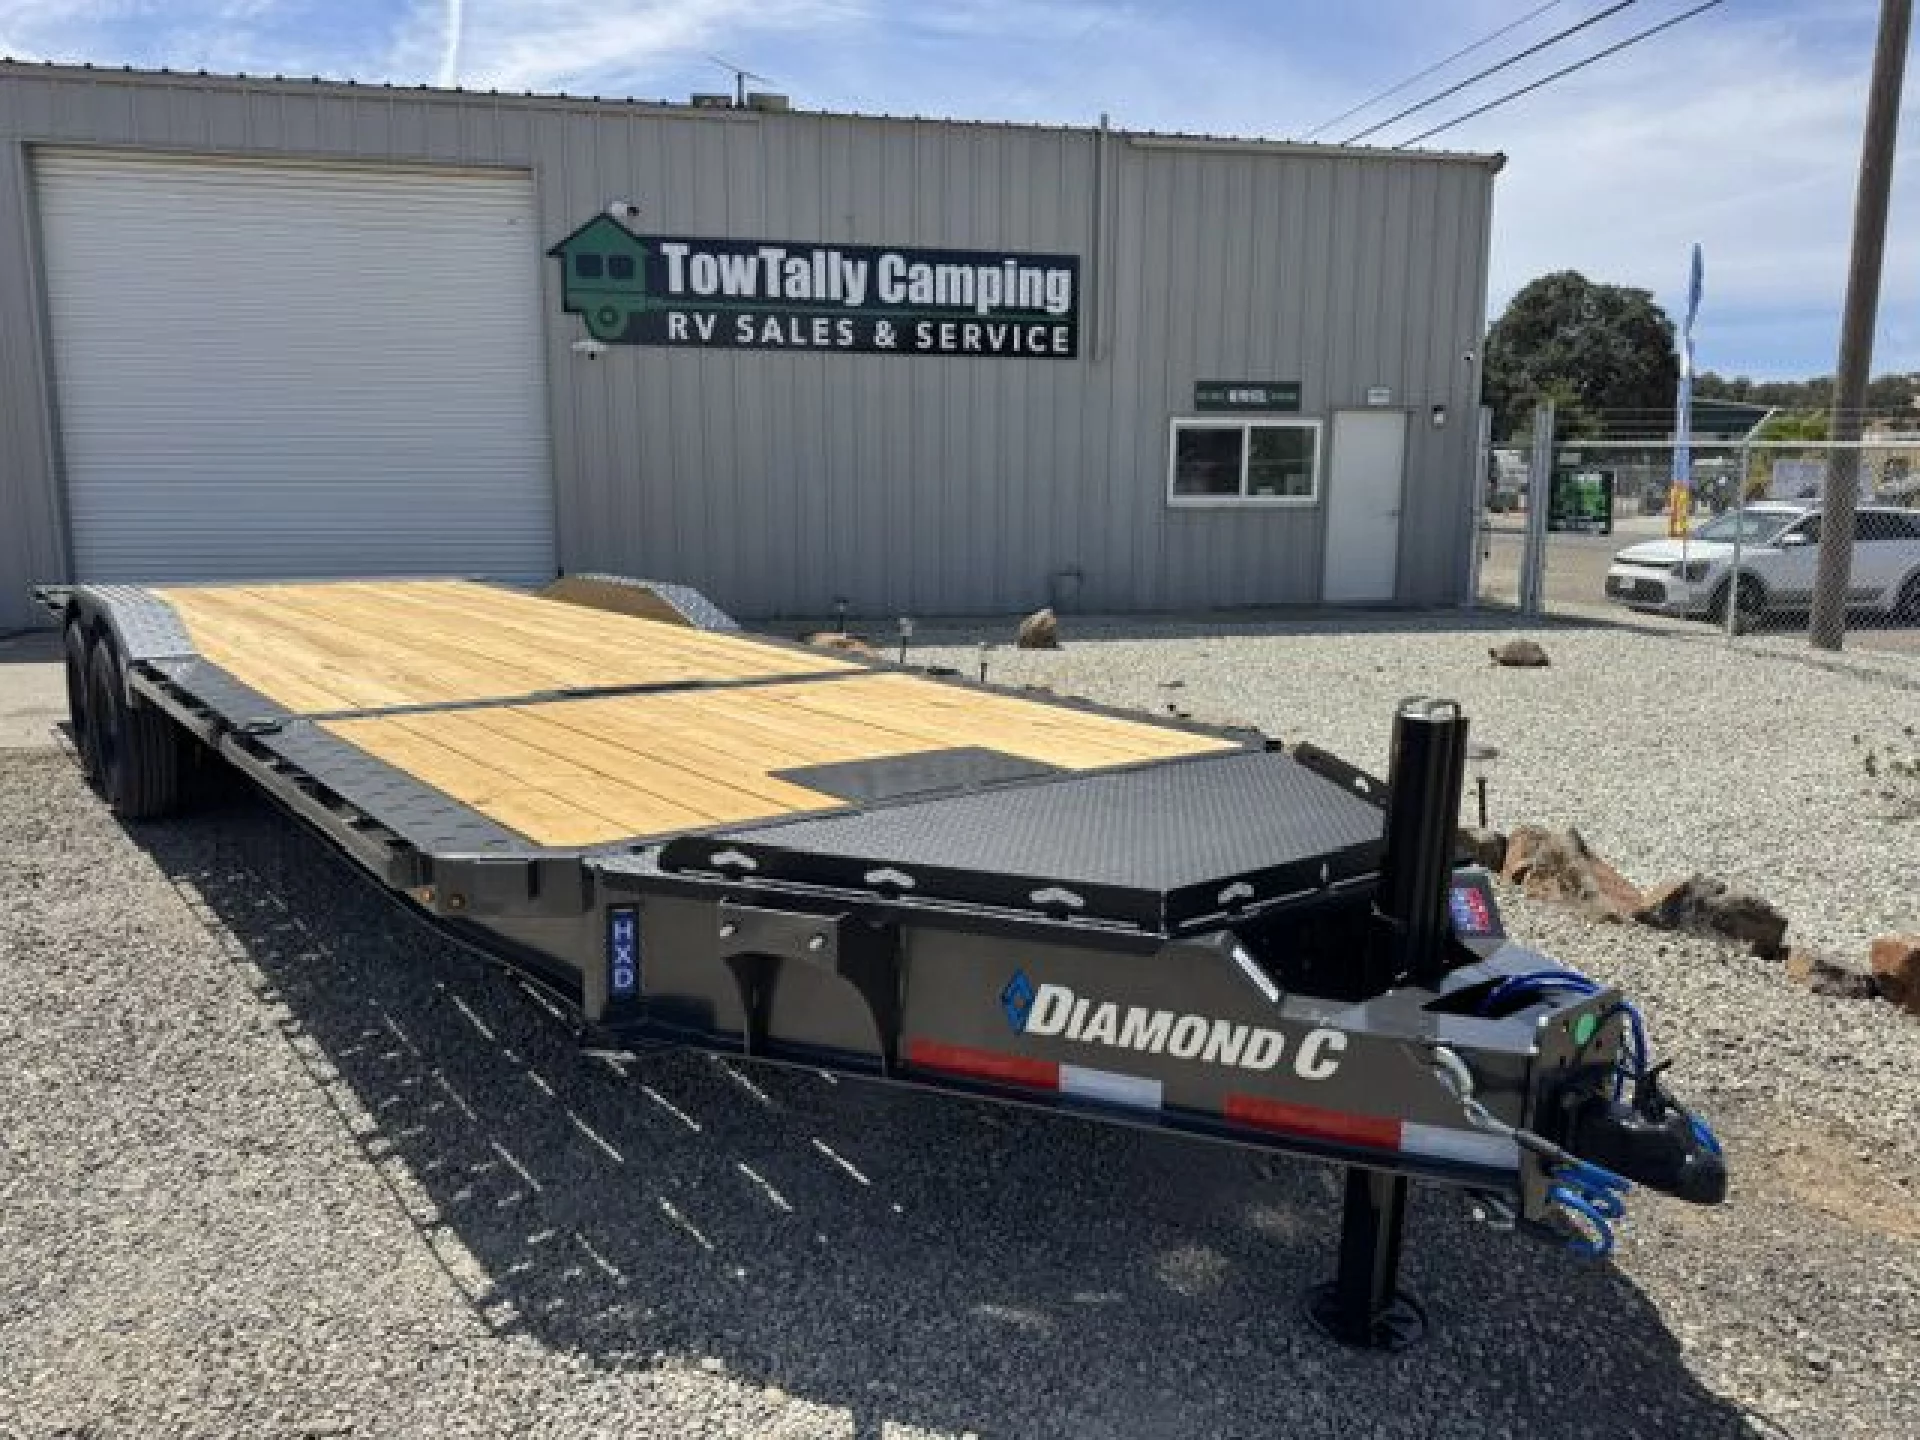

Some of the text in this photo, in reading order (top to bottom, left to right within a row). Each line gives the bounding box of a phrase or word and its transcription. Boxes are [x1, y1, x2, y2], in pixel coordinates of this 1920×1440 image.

[661, 243, 1071, 315] TowTally Camping
[669, 311, 1069, 353] RV SALES & SERVICE
[614, 920, 633, 988] HXD
[1294, 1028, 1348, 1080] C
